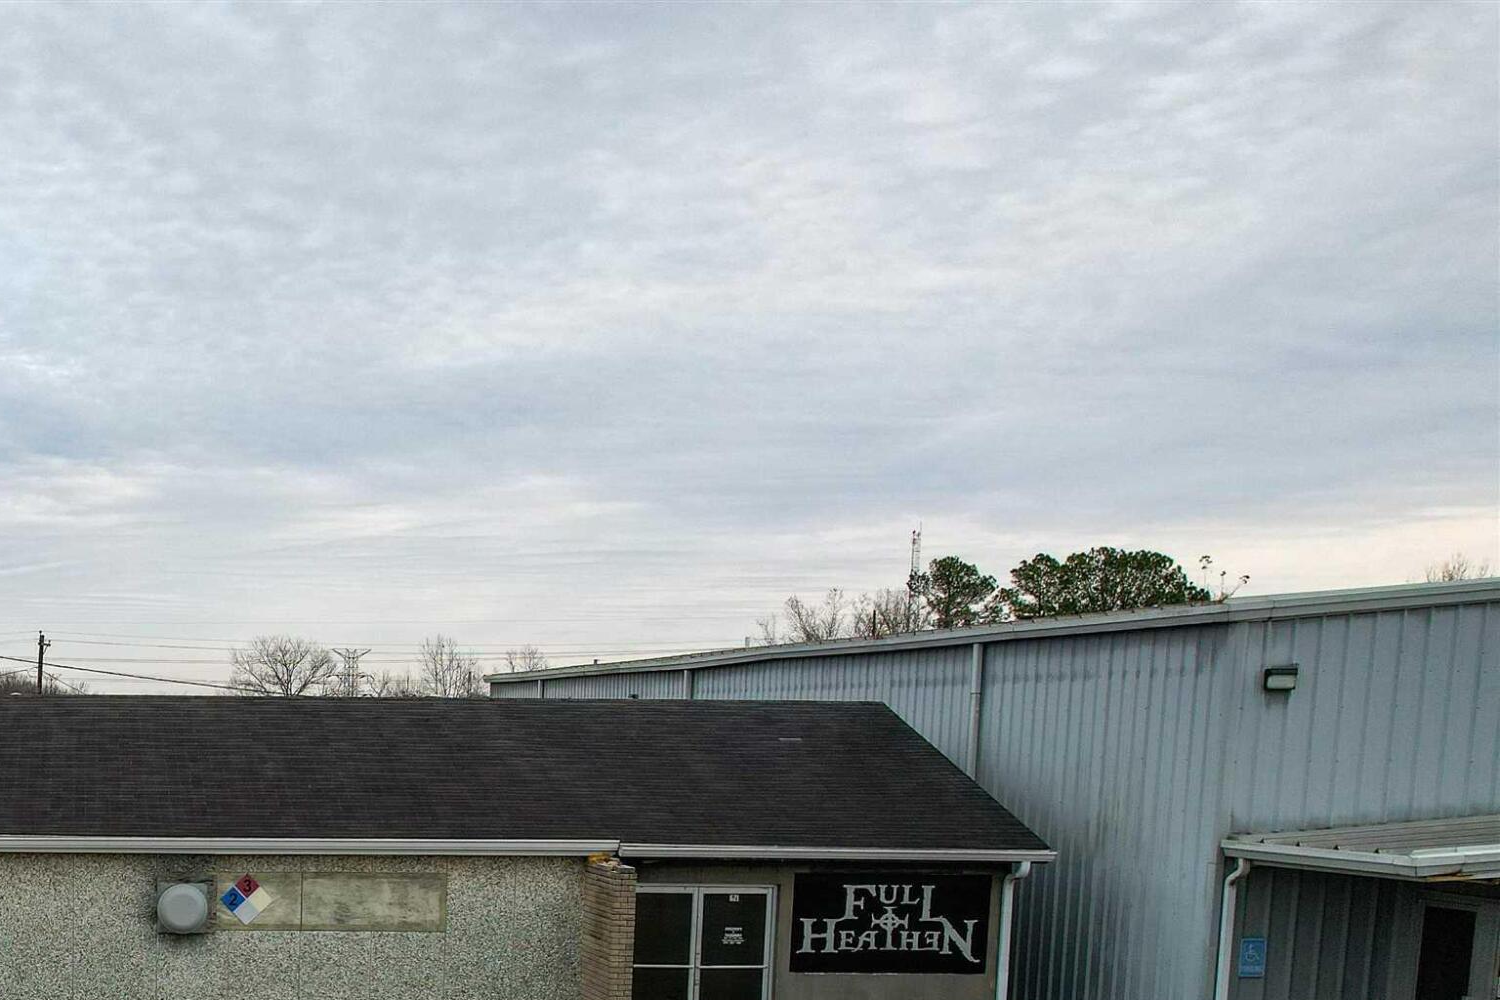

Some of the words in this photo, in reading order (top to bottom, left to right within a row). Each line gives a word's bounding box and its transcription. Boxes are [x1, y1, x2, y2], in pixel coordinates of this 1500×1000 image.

[243, 879, 252, 892] 3
[229, 892, 238, 905] 2
[842, 884, 945, 922] FULL
[796, 907, 980, 963] HEATHEN
